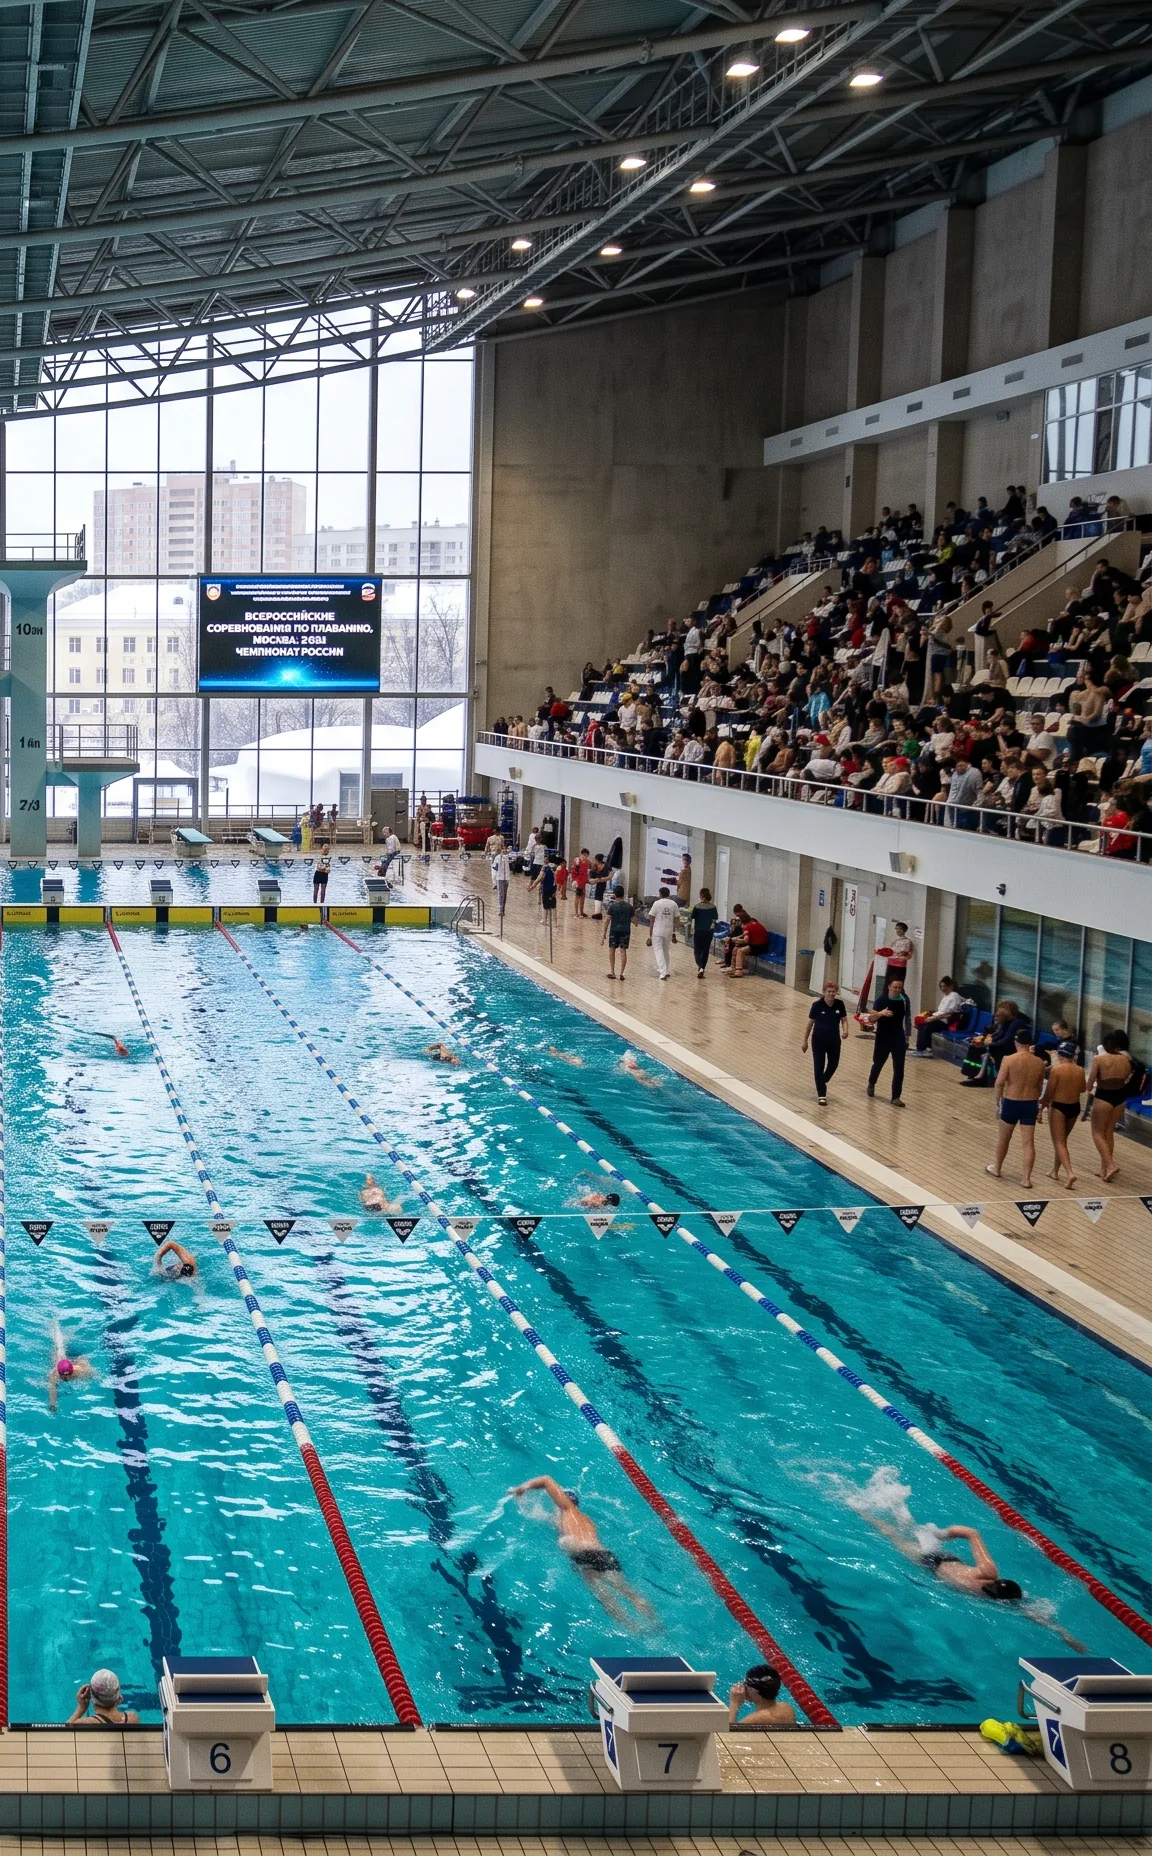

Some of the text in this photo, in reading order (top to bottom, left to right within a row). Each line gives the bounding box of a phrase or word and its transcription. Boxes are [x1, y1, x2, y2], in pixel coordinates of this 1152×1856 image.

[293, 623, 309, 633] ПО
[209, 1742, 231, 1774] 6
[657, 1743, 679, 1774] 7
[1109, 1742, 1132, 1775] 8
